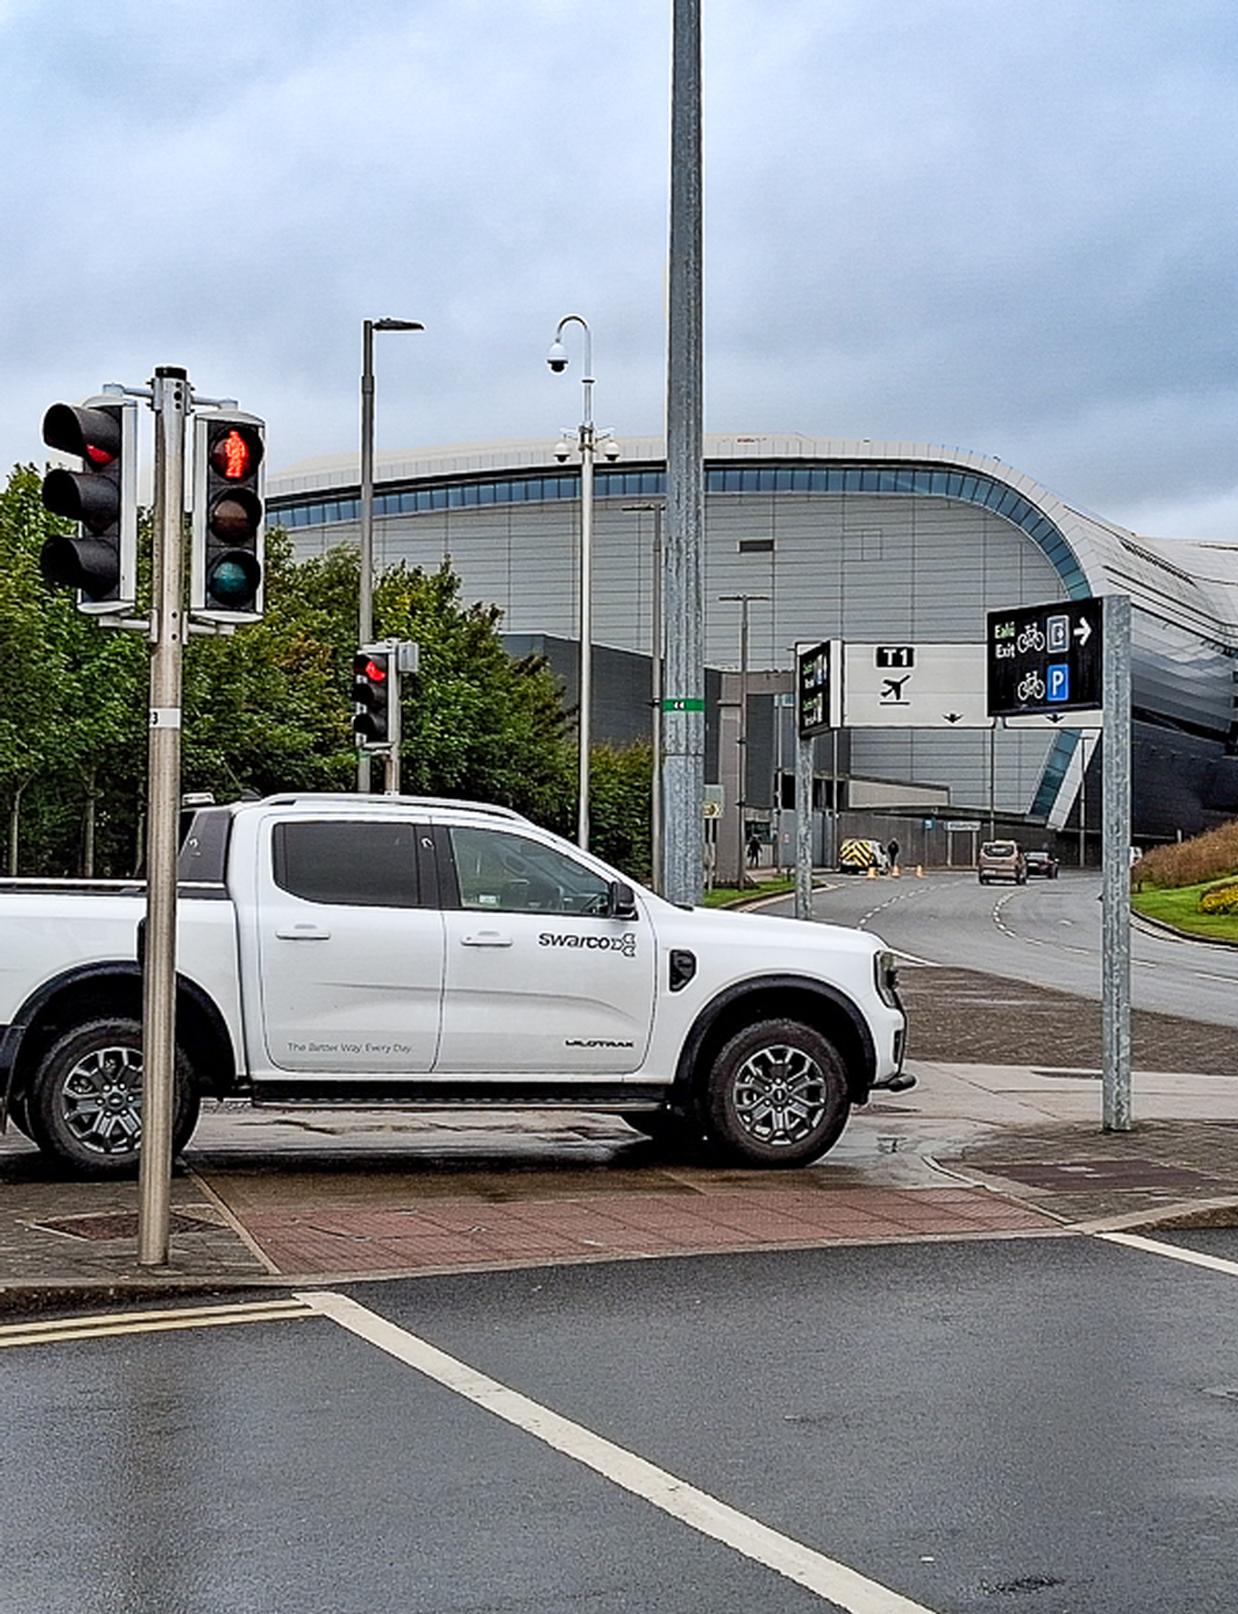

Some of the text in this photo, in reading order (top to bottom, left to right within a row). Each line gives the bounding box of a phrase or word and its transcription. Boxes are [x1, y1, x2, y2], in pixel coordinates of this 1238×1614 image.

[883, 648, 908, 666] T1
[1052, 670, 1064, 697] P
[287, 1042, 306, 1052] The
